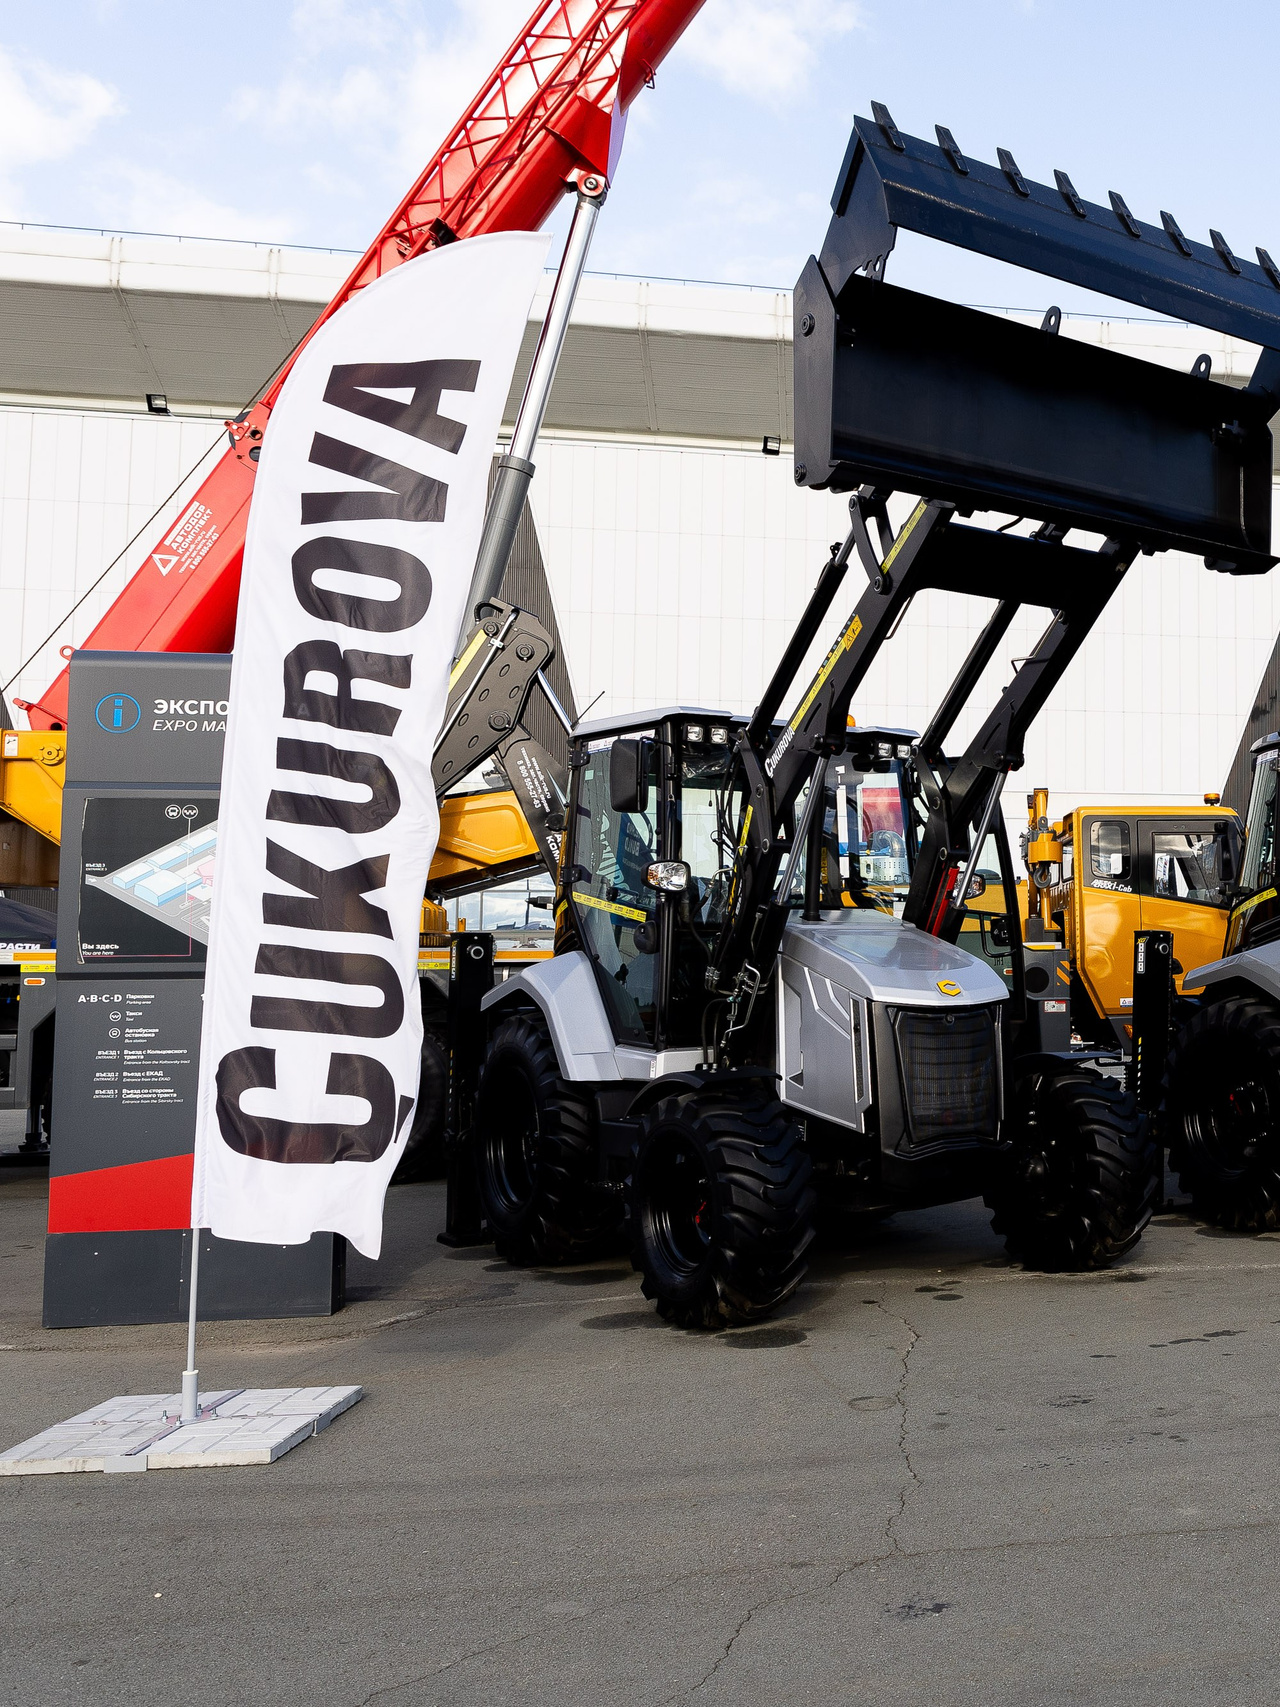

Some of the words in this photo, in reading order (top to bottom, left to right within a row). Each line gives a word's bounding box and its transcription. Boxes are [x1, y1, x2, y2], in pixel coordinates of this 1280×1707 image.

[171, 504, 206, 550] АВТОДОР
[176, 508, 213, 554] КОМПЛЕКТ
[152, 720, 198, 732] EXPO
[764, 726, 795, 778] ÇUKUROVA
